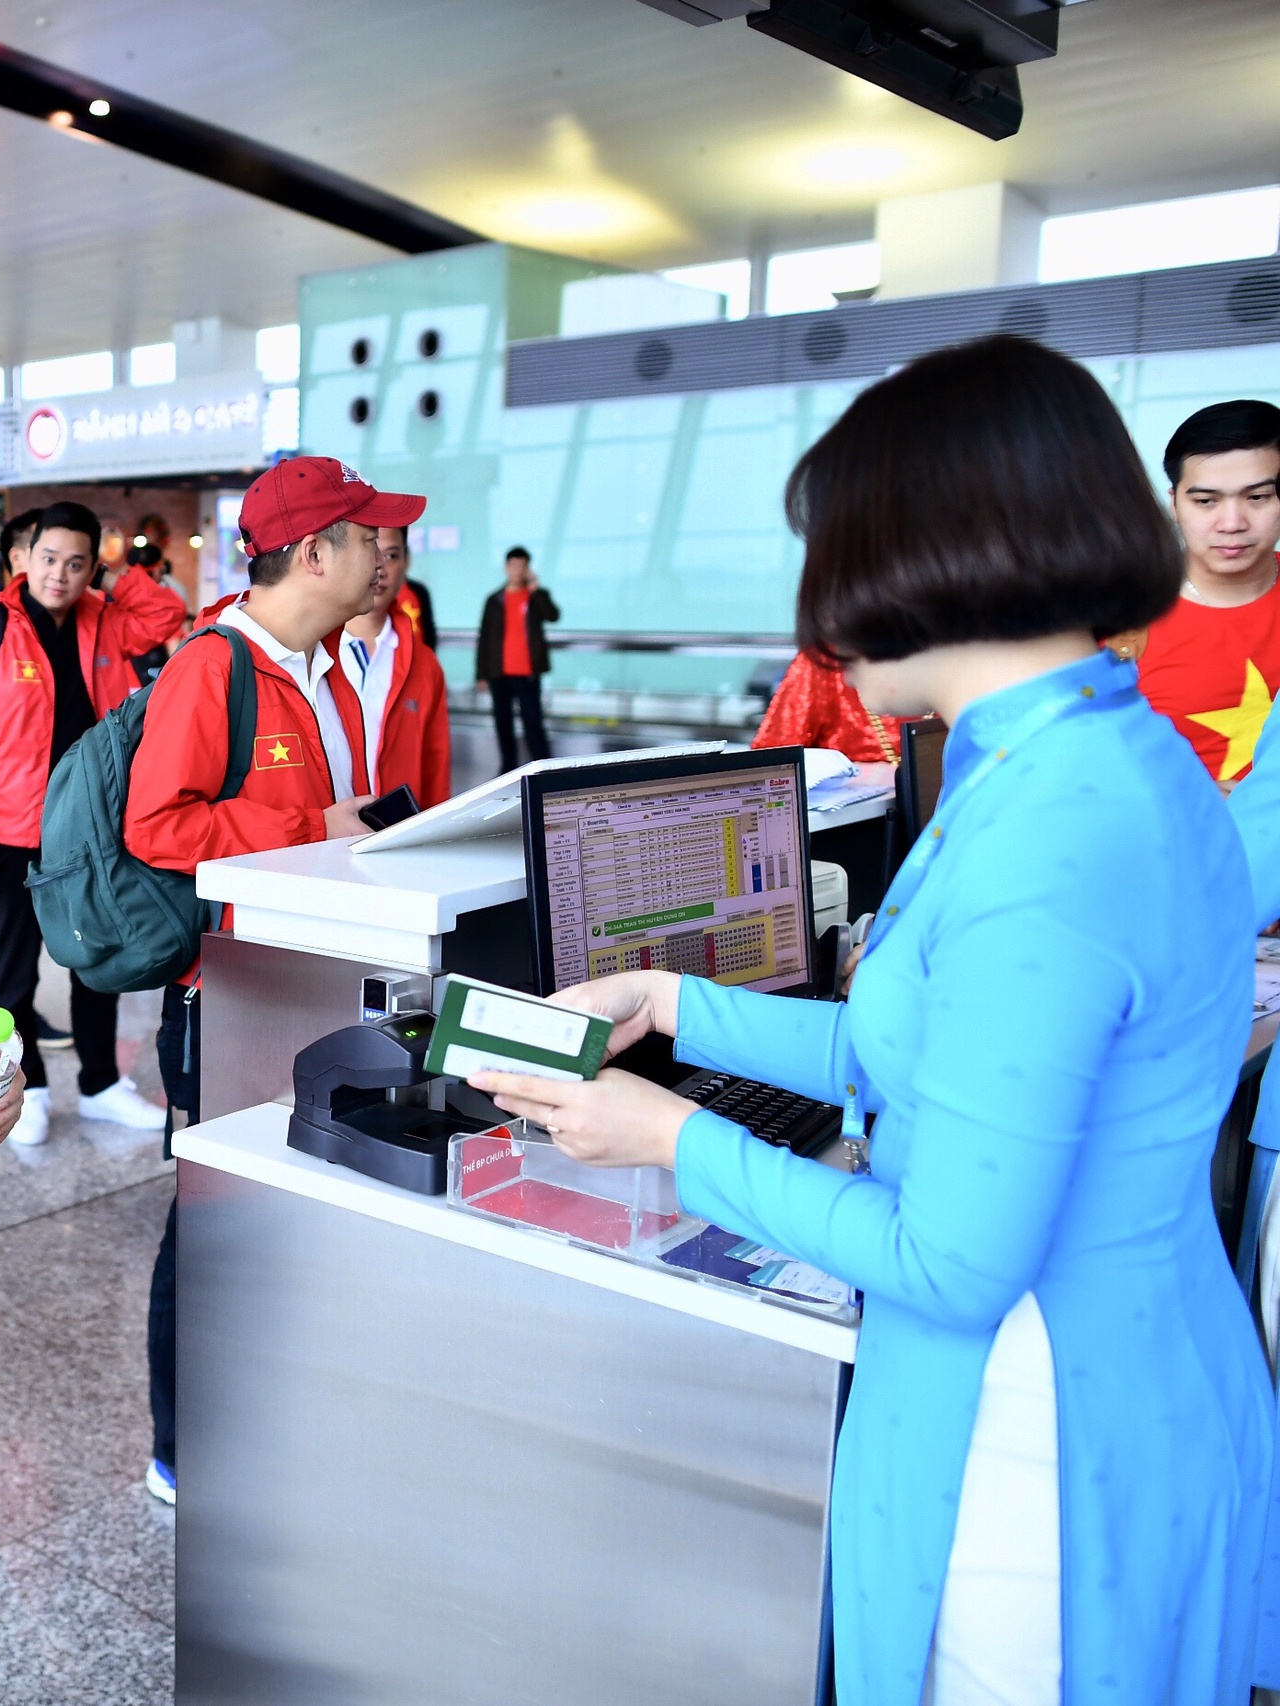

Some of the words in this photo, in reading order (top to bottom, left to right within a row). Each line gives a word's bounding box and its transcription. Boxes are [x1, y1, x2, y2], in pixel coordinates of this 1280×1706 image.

[769, 779, 790, 787] Sabre
[587, 819, 609, 827] Boarding
[623, 920, 637, 928] TRAN
[462, 1160, 475, 1175] THẺ
[476, 1159, 485, 1169] BP
[486, 1150, 505, 1165] CHƯA
